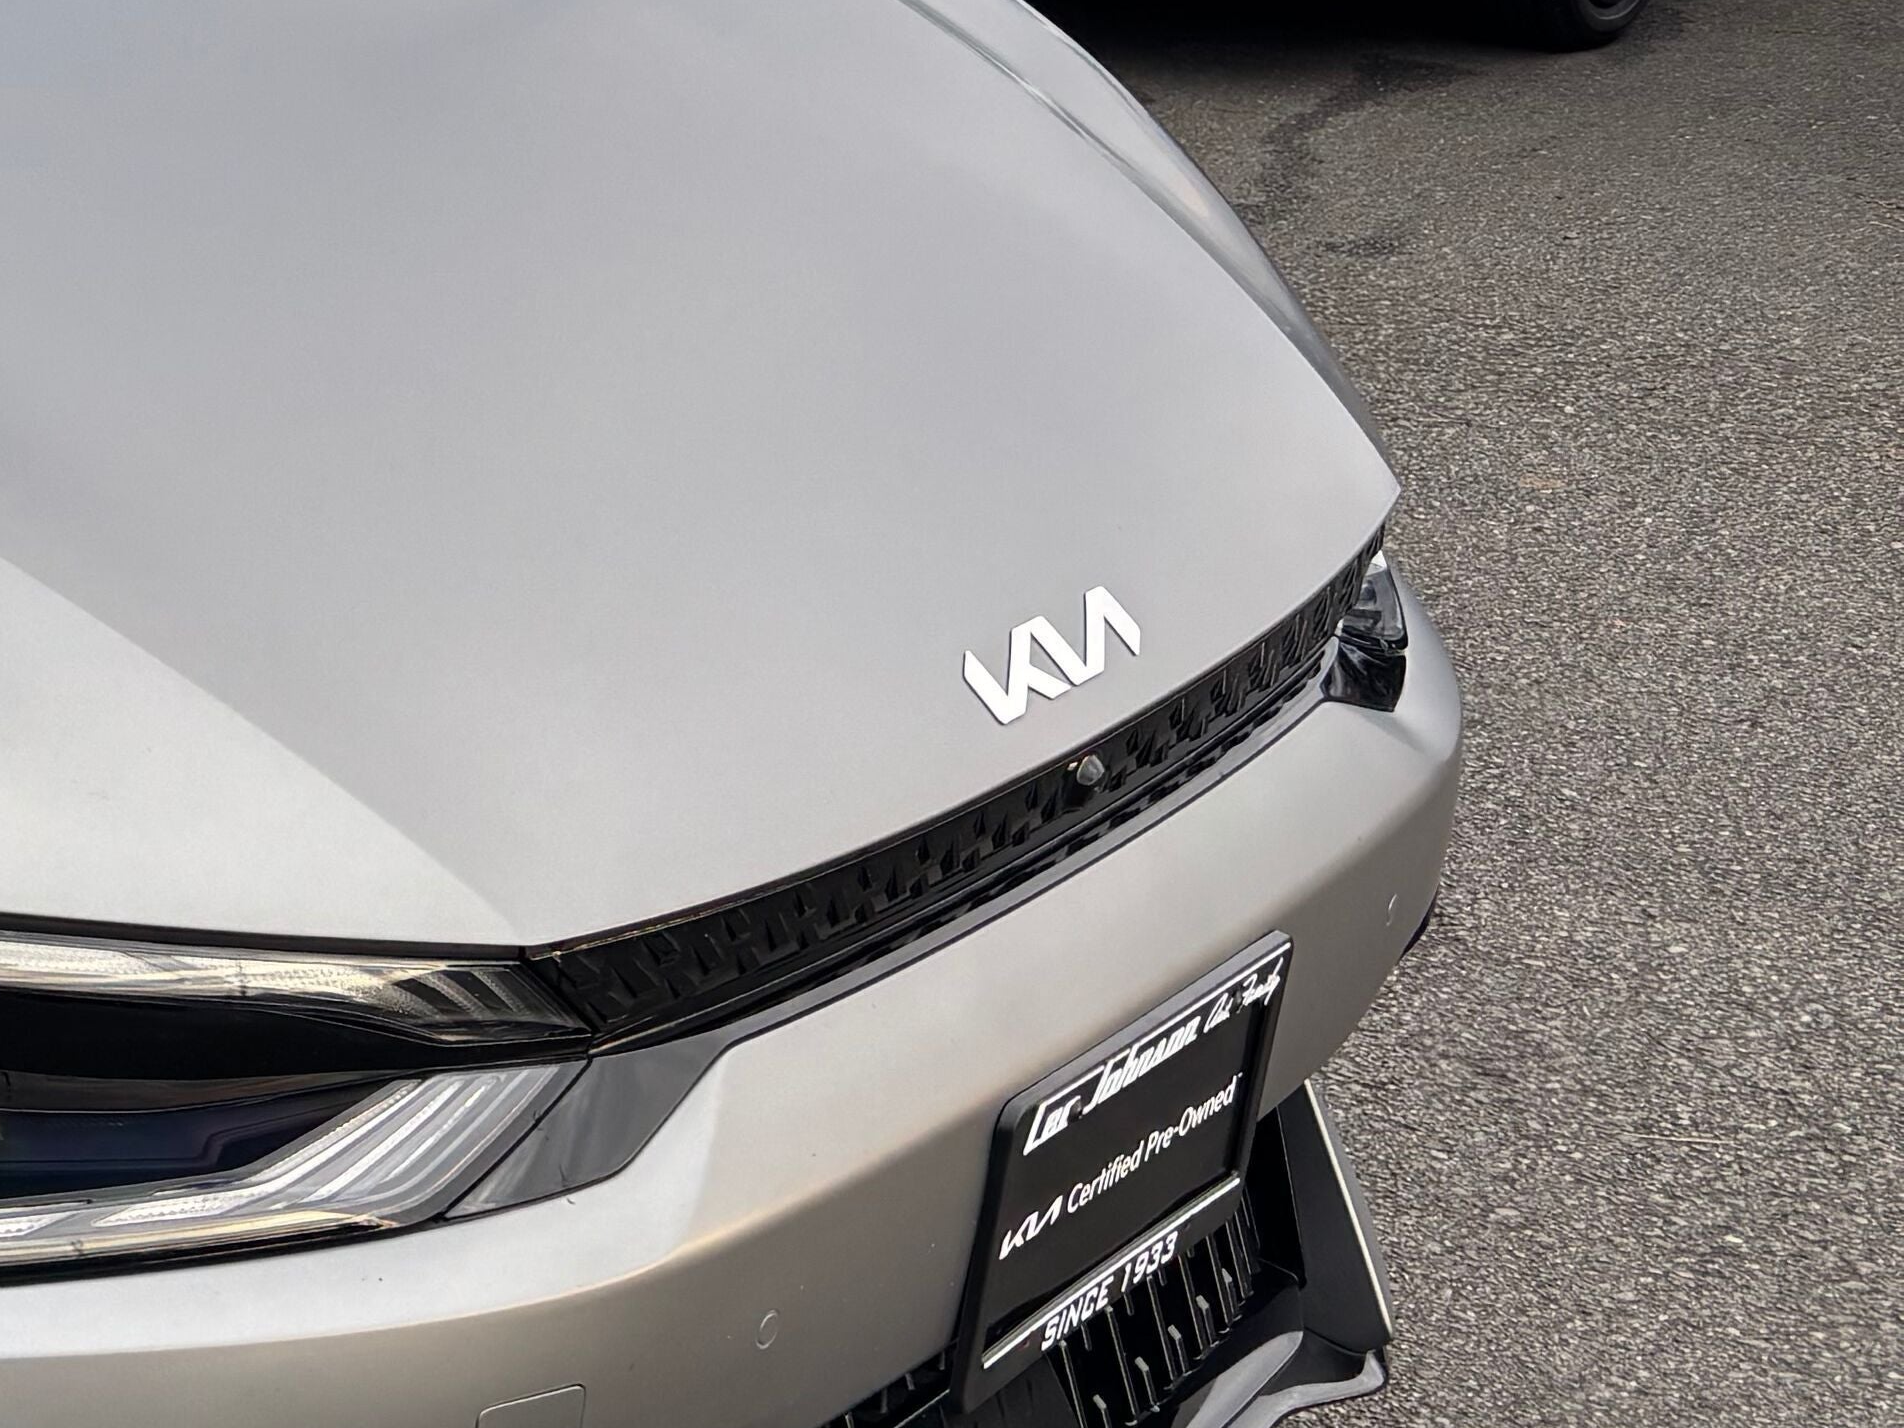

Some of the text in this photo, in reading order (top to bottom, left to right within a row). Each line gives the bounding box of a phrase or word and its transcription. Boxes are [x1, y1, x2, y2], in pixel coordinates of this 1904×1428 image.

[962, 585, 1141, 725] KIA
[1082, 1015, 1202, 1115] Johnson
[998, 1074, 1238, 1261] KIA Certified Pre-Owned
[1041, 1230, 1179, 1352] SINCE 1933
